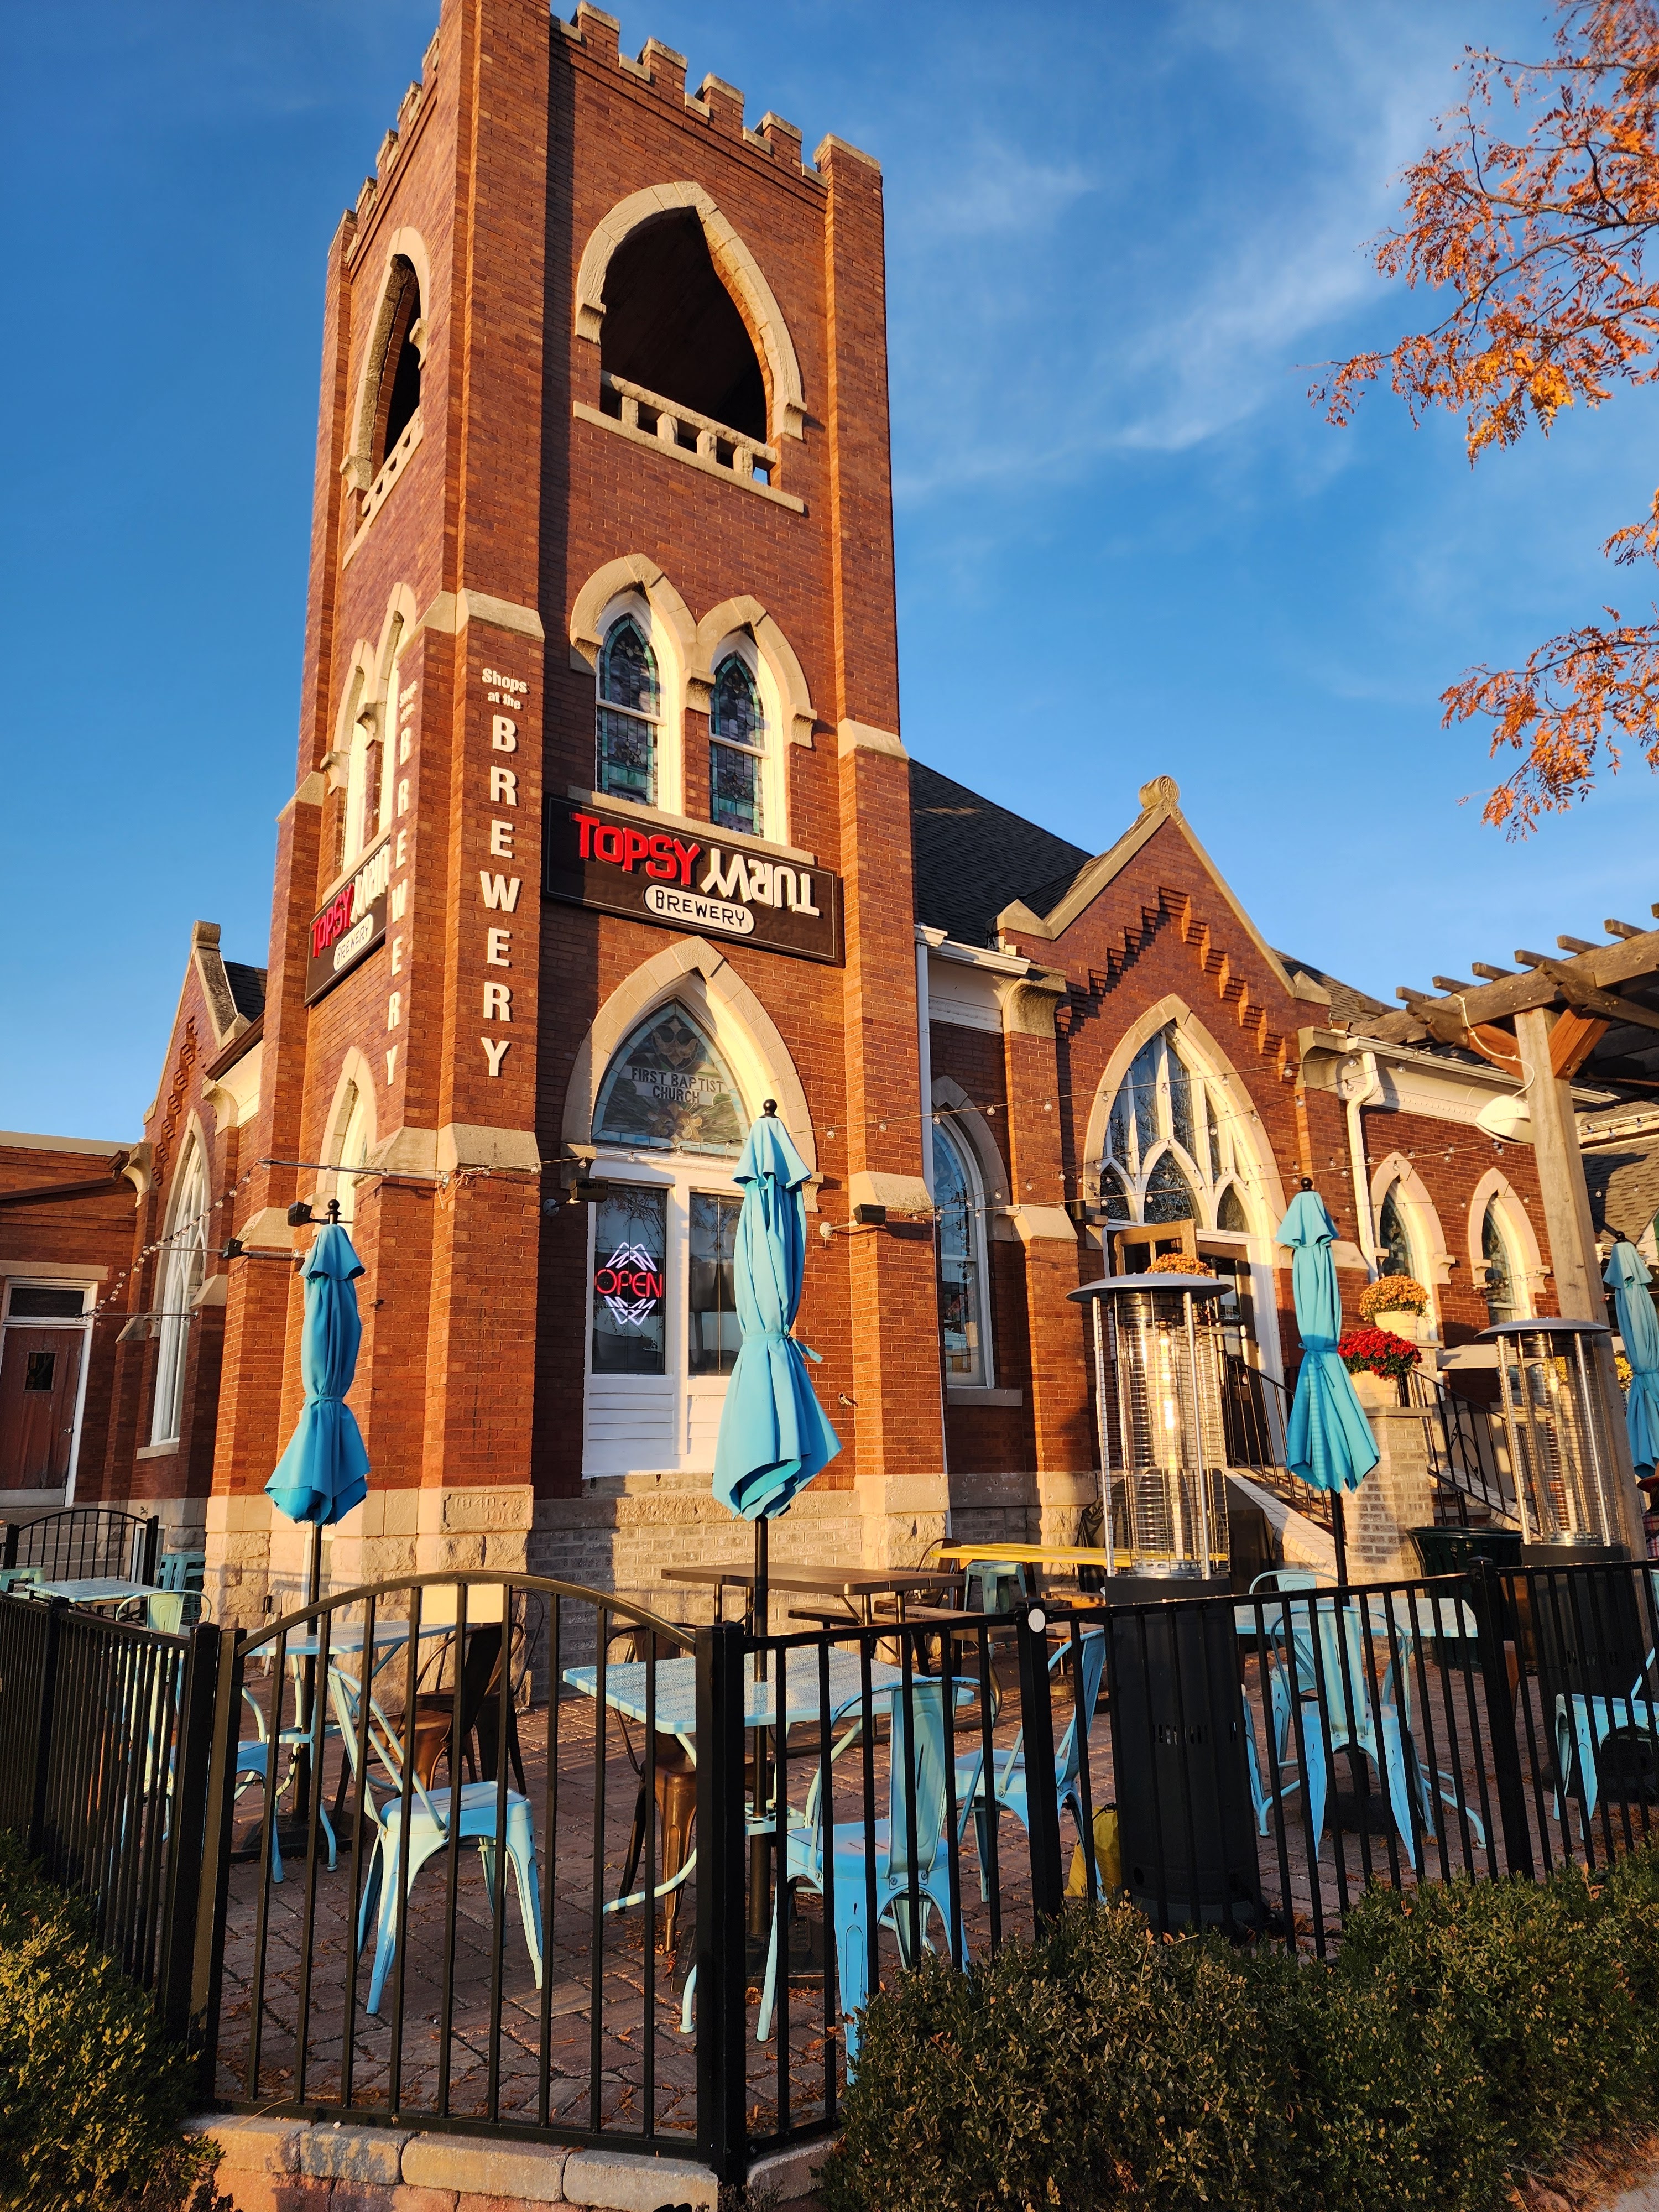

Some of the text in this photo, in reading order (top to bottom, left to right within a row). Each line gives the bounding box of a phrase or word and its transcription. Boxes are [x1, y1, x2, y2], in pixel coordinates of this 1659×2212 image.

[482, 667, 527, 693] Shops
[487, 692, 521, 709] at the
[570, 812, 820, 918] TOPSY TURVY
[311, 844, 390, 958] TOPSY URVY
[387, 727, 410, 1086] BREWERY
[480, 714, 520, 1077] BREWERY
[655, 890, 745, 927] BREWERY
[337, 919, 369, 965] BREWERY
[632, 1067, 724, 1093] FIRST BAPTIST
[653, 1085, 700, 1104] CHURCH
[594, 1268, 662, 1298] OPEN
